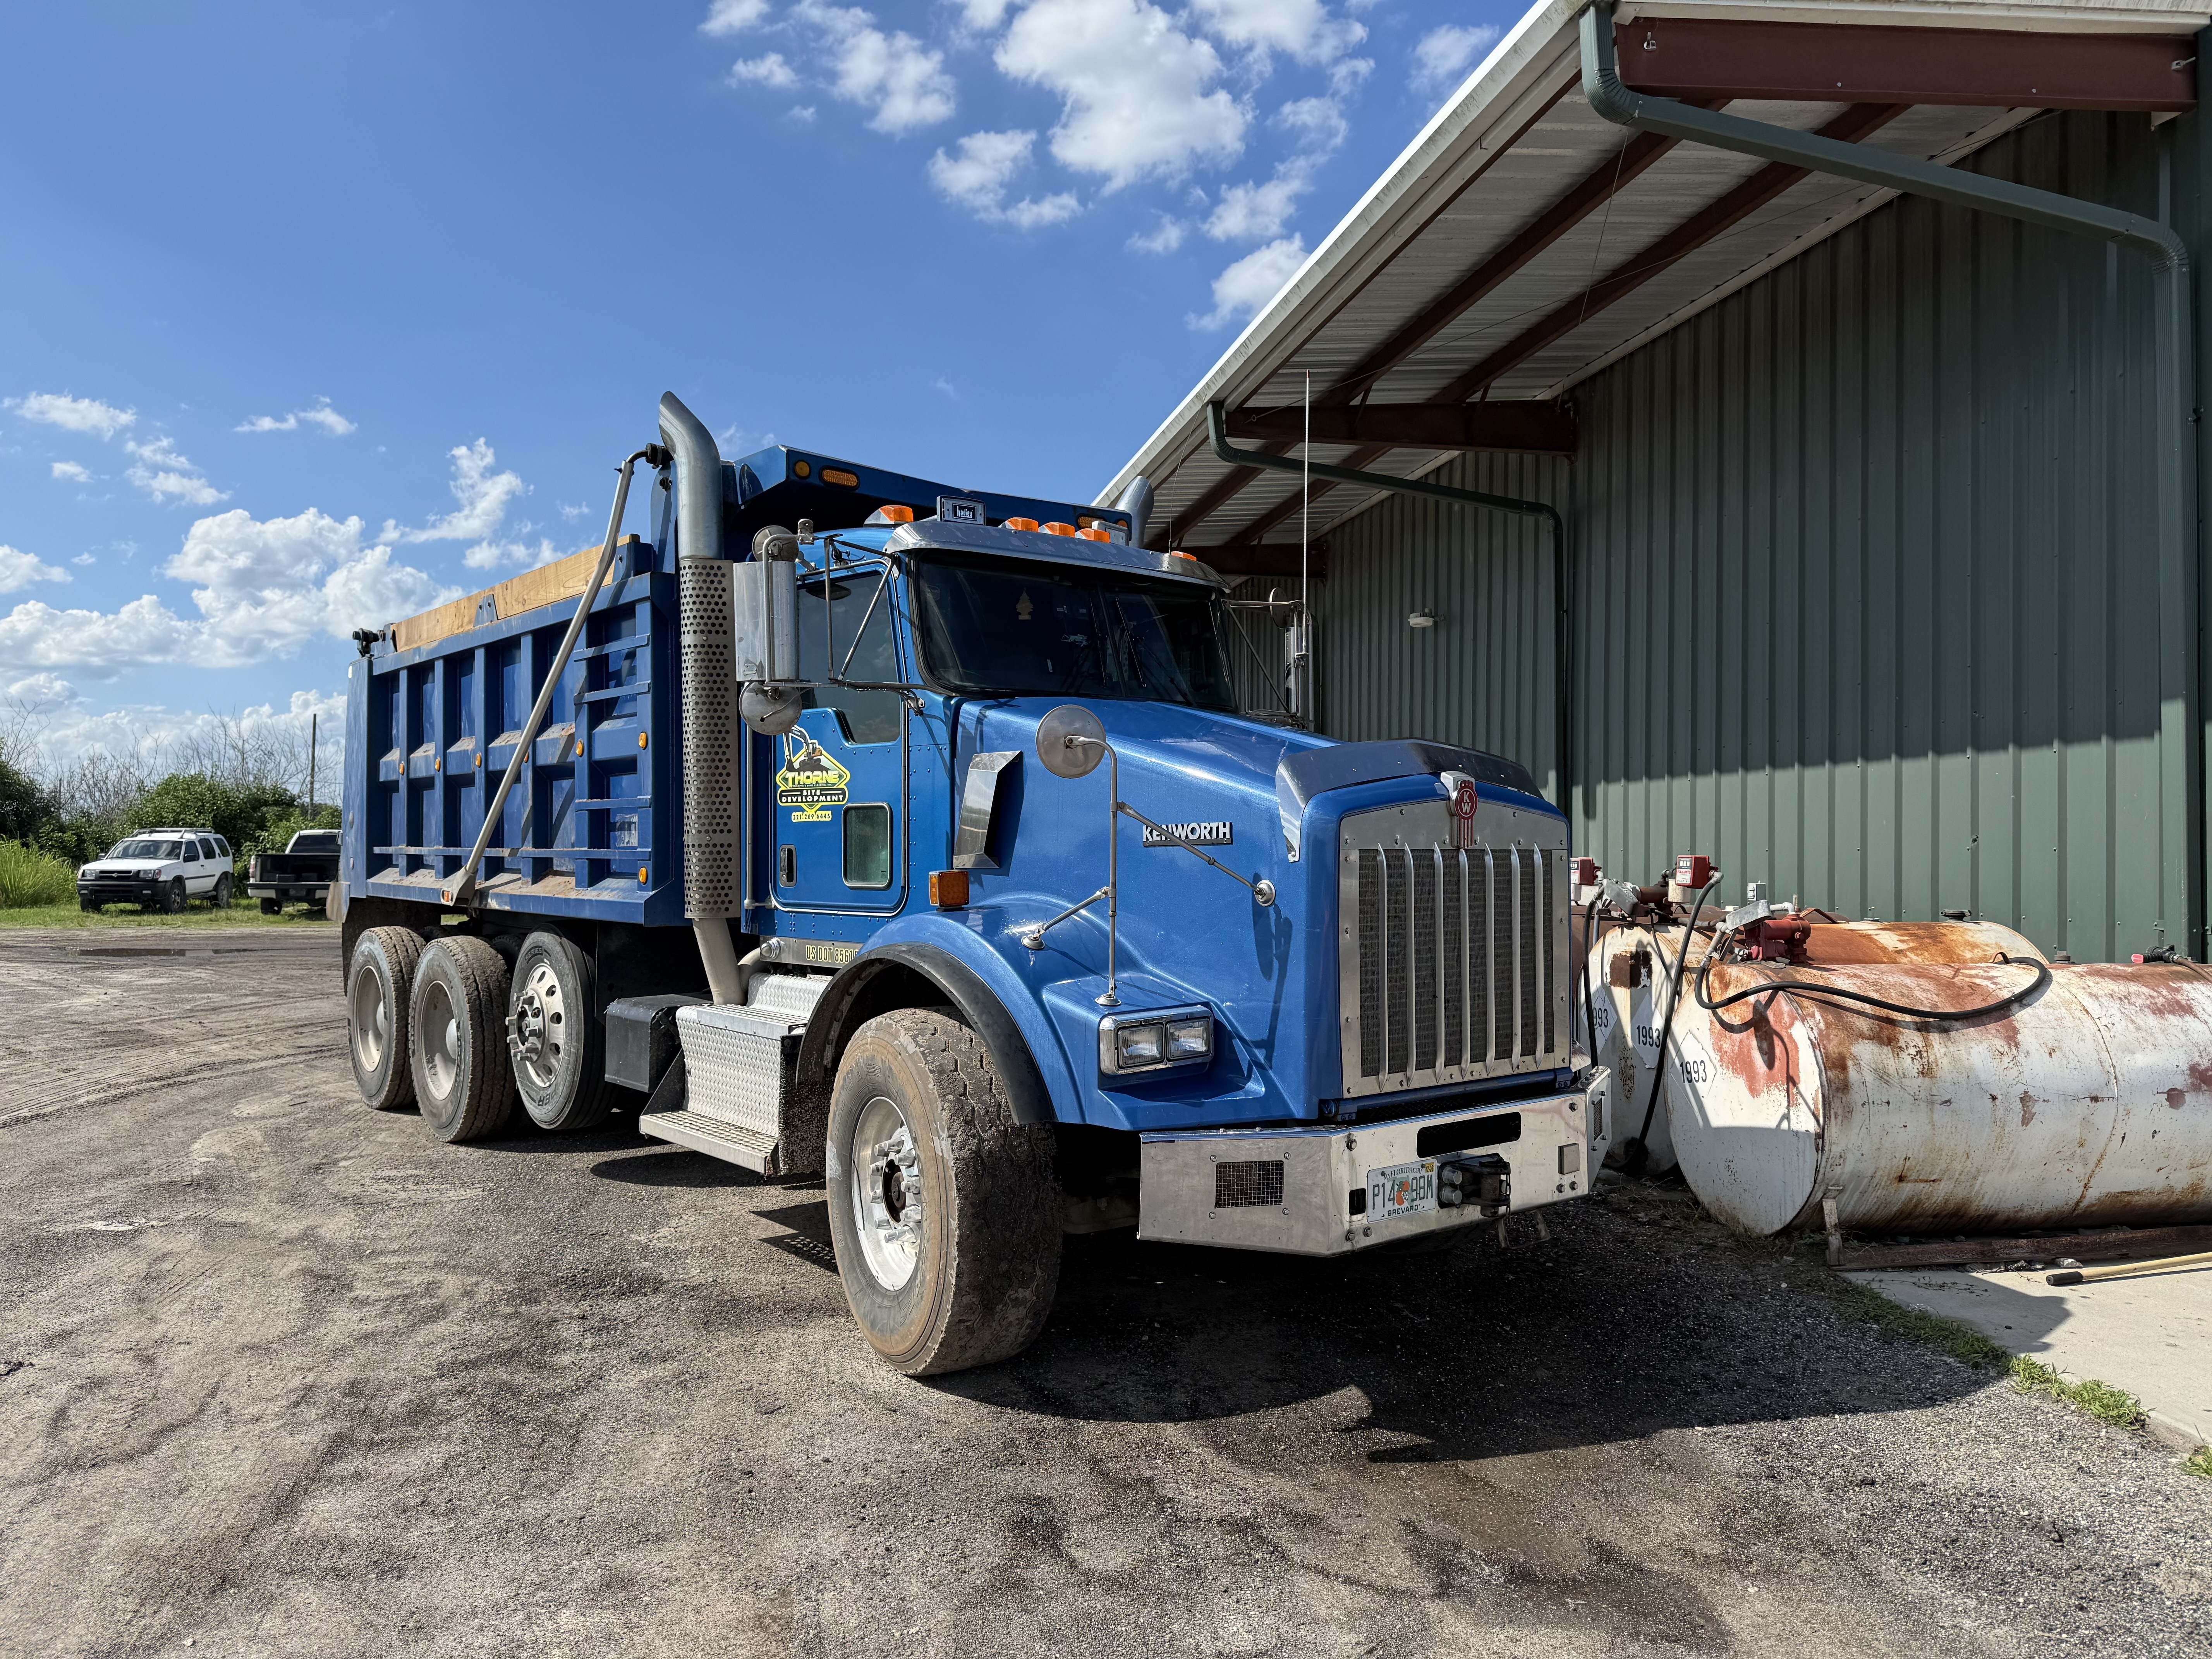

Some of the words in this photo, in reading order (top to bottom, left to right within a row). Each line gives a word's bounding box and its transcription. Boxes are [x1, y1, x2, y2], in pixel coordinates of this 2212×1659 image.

[785, 770, 840, 788] THORNE
[1143, 821, 1230, 842] KENWORTH
[525, 947, 542, 962] SERIES
[806, 945, 816, 961] US
[817, 946, 833, 962] DOT
[1593, 1007, 1608, 1028] 993
[1637, 1025, 1661, 1048] 1993
[1679, 1060, 1707, 1084] 1993
[1372, 1180, 1395, 1210] P14
[1411, 1175, 1433, 1202] 98M
[1388, 1205, 1419, 1217] BREVARD
